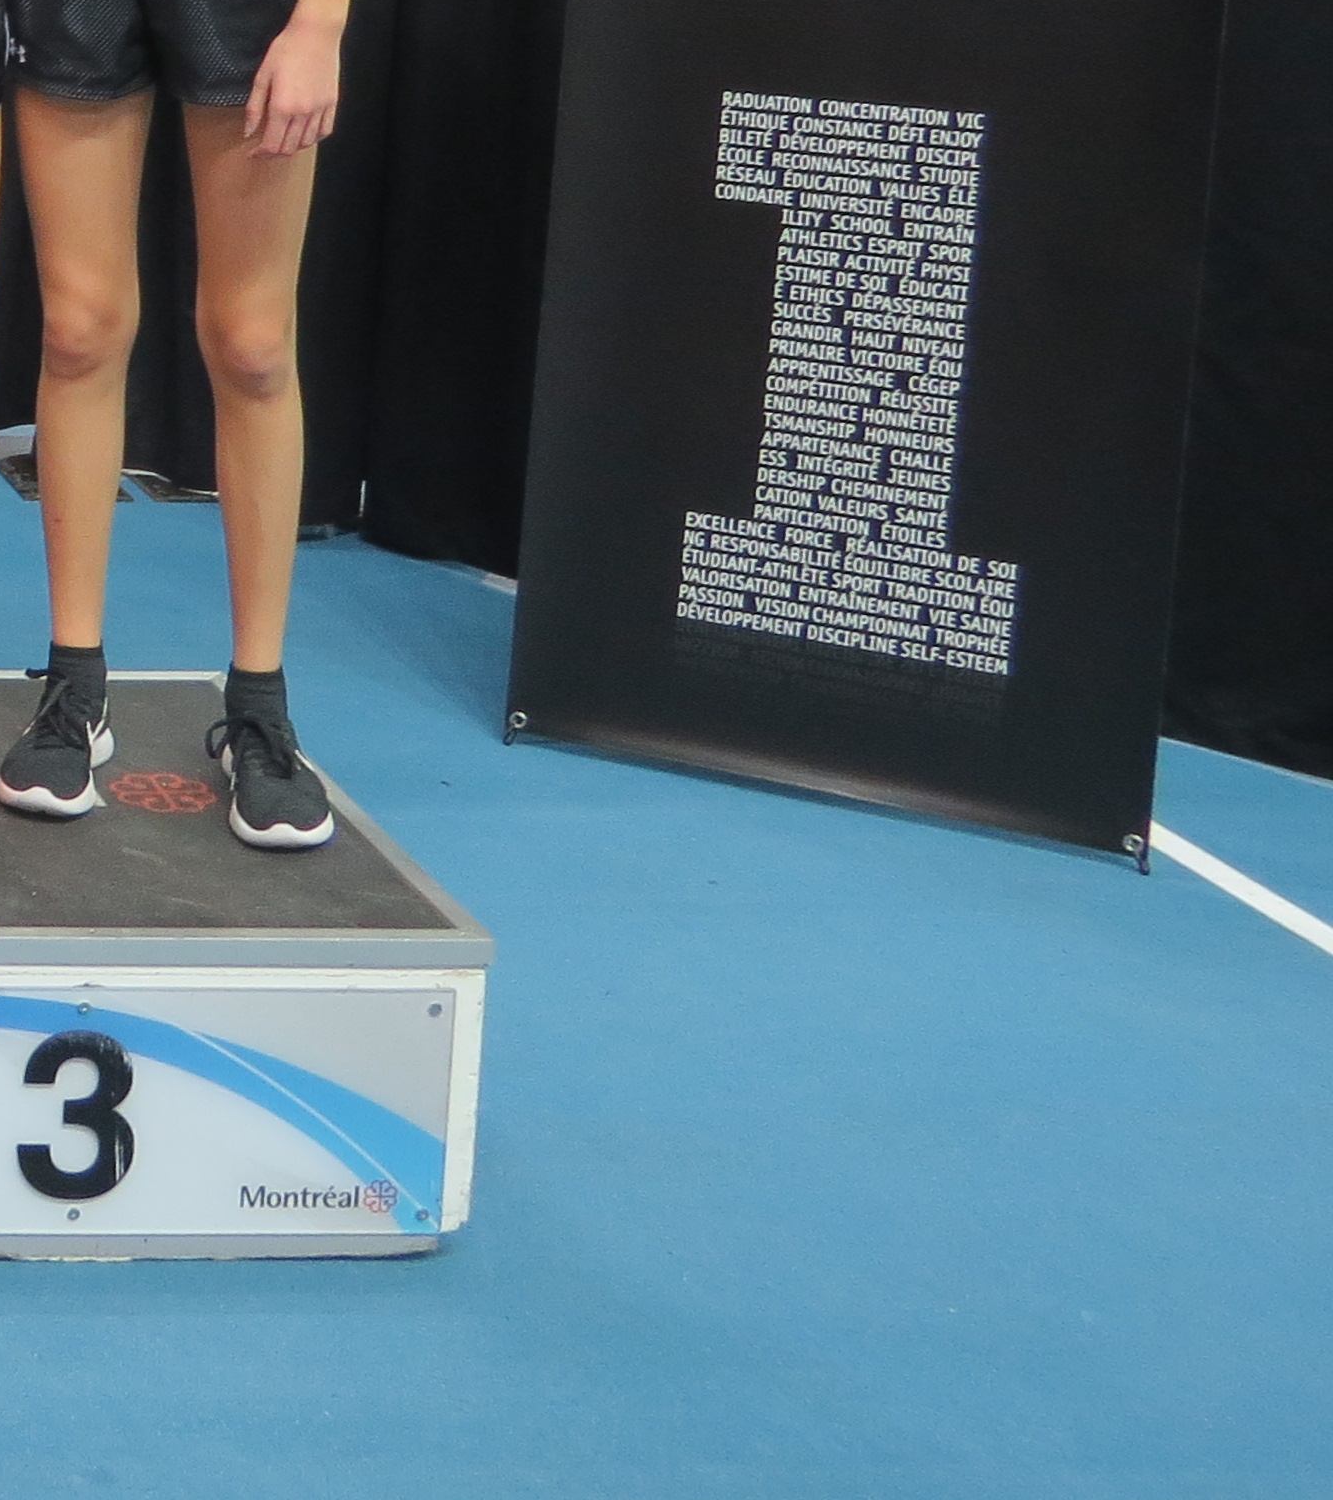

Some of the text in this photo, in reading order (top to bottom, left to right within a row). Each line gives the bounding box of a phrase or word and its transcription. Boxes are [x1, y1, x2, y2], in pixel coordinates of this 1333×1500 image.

[720, 106, 981, 148] ÉTHIQUE CONSTANCE DÉFI ENJOY
[721, 91, 984, 130] RADUATION CONCENTRATION VIC
[717, 143, 978, 187] ÉCOLE RECONNAISSANCE STUDIE
[719, 125, 979, 168] BILETÉ DÉVELOPPEMENT DISCIPL
[714, 182, 975, 225] CONDAIRE UNIVERSITÉ ENCADRE
[715, 161, 977, 206] RÉSEAU ÉDUCATION VALUES ÉLÈ
[779, 226, 971, 263] ATHLETICS ESPRIT SPOR
[781, 207, 974, 244] ILITY SCHOOL ENTRAÎN
[778, 244, 969, 282] PLAISIR ACTIVITÉ PHYSI
[771, 318, 963, 358] GRANDIR HAUT NIVEAU
[765, 371, 958, 415] COMPÉTITION RÉUSSITE
[757, 465, 948, 510] DERSHIP CHEMINEMENT
[681, 544, 1014, 618] ÉTUDIANT-ATHLÈTE SPORT TRADITION ÉQU
[676, 599, 1008, 675] DÉVELOPPEMENT DISCIPLINE SELF-ESTEEM
[16, 1028, 135, 1200] 3
[239, 1183, 359, 1211] Montréal
